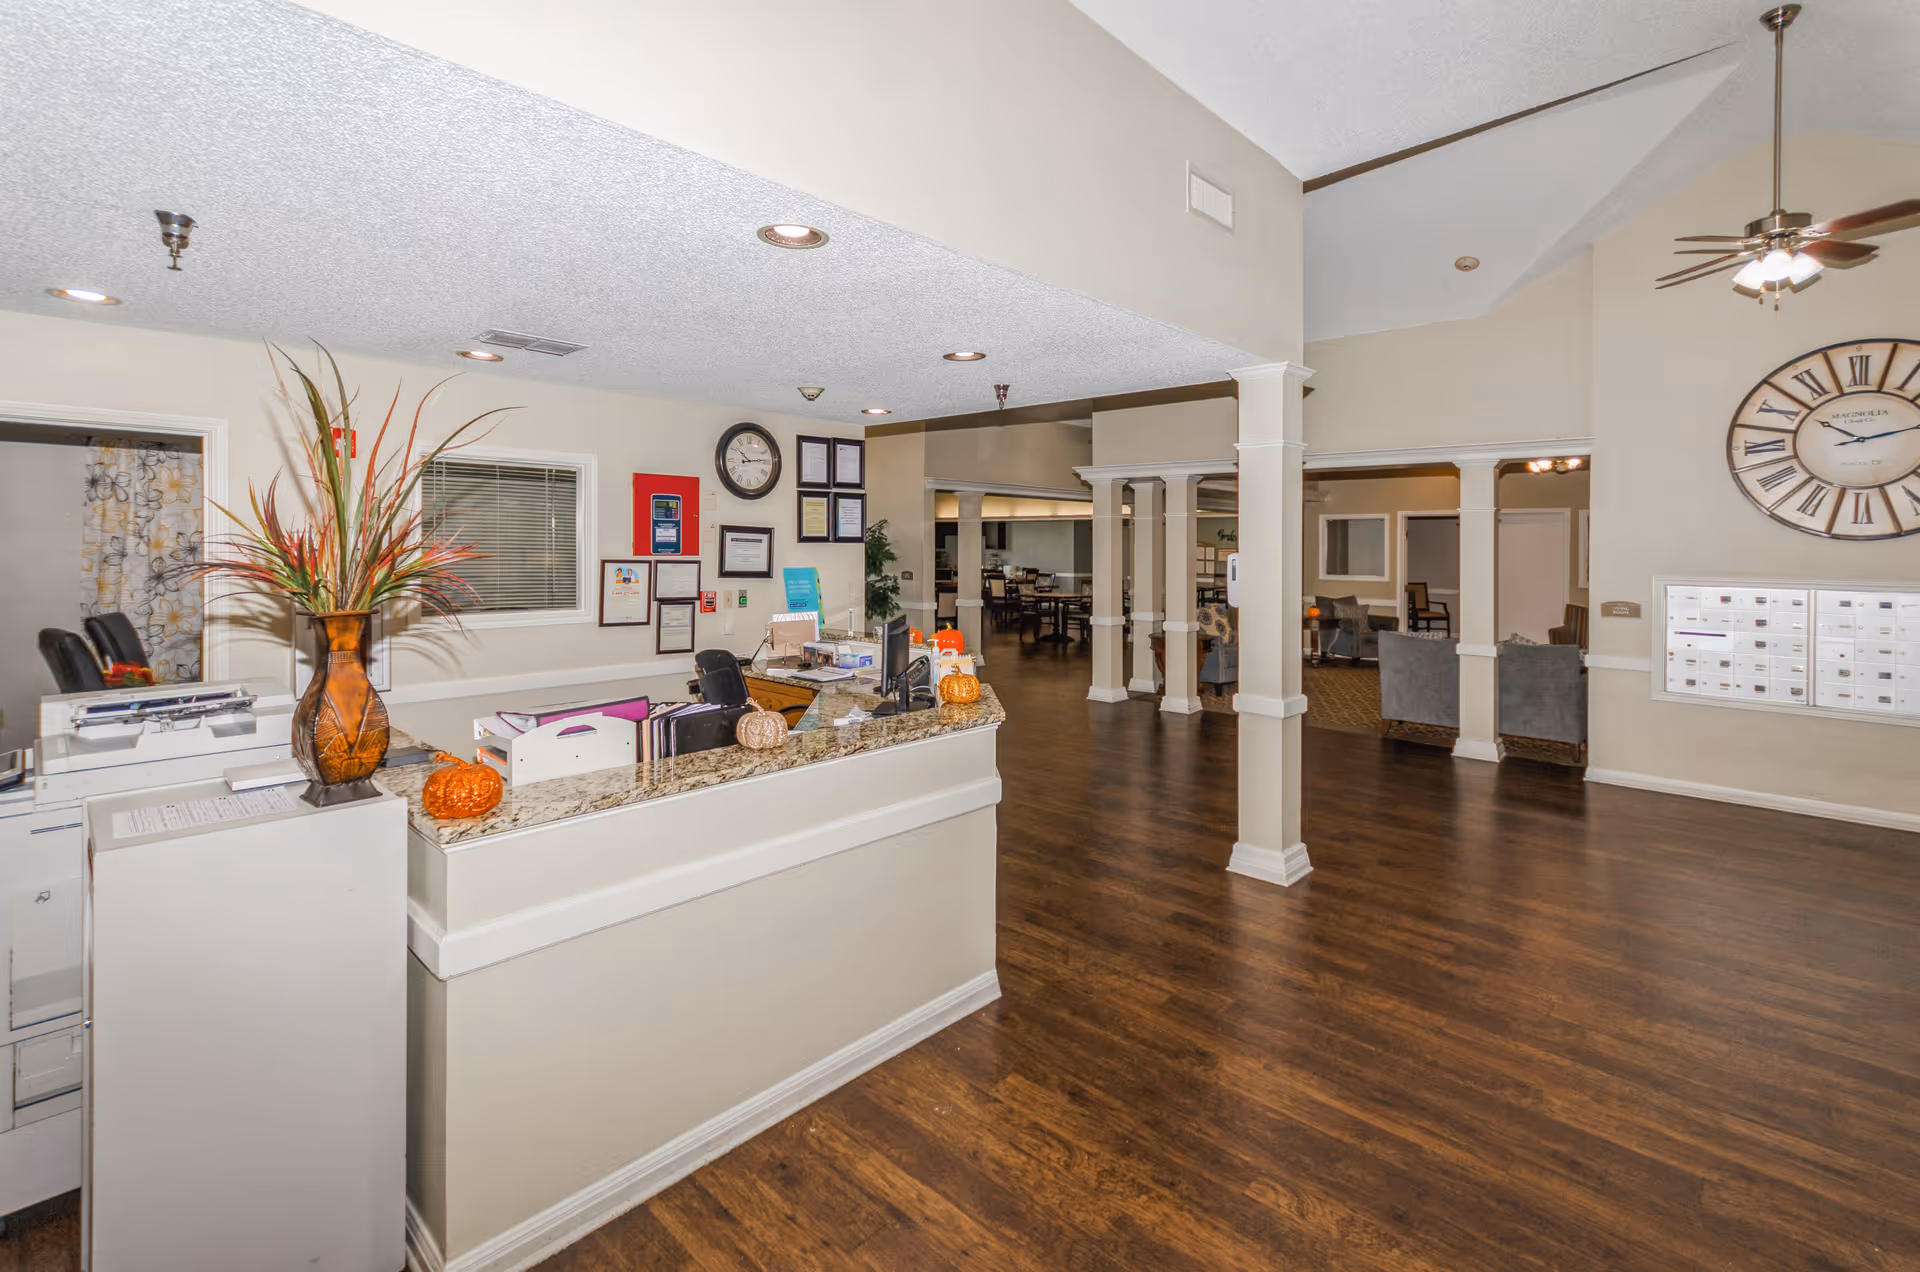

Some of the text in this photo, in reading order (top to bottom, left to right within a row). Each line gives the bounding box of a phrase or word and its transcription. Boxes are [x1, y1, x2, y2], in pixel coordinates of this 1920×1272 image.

[1791, 368, 1831, 401] XI
[1848, 354, 1872, 387] XII
[1756, 399, 1801, 424] X
[1832, 409, 1889, 419] MAGNOLIA
[1744, 438, 1786, 456] IX
[1796, 484, 1831, 517] VII
[1850, 491, 1874, 524] VI
